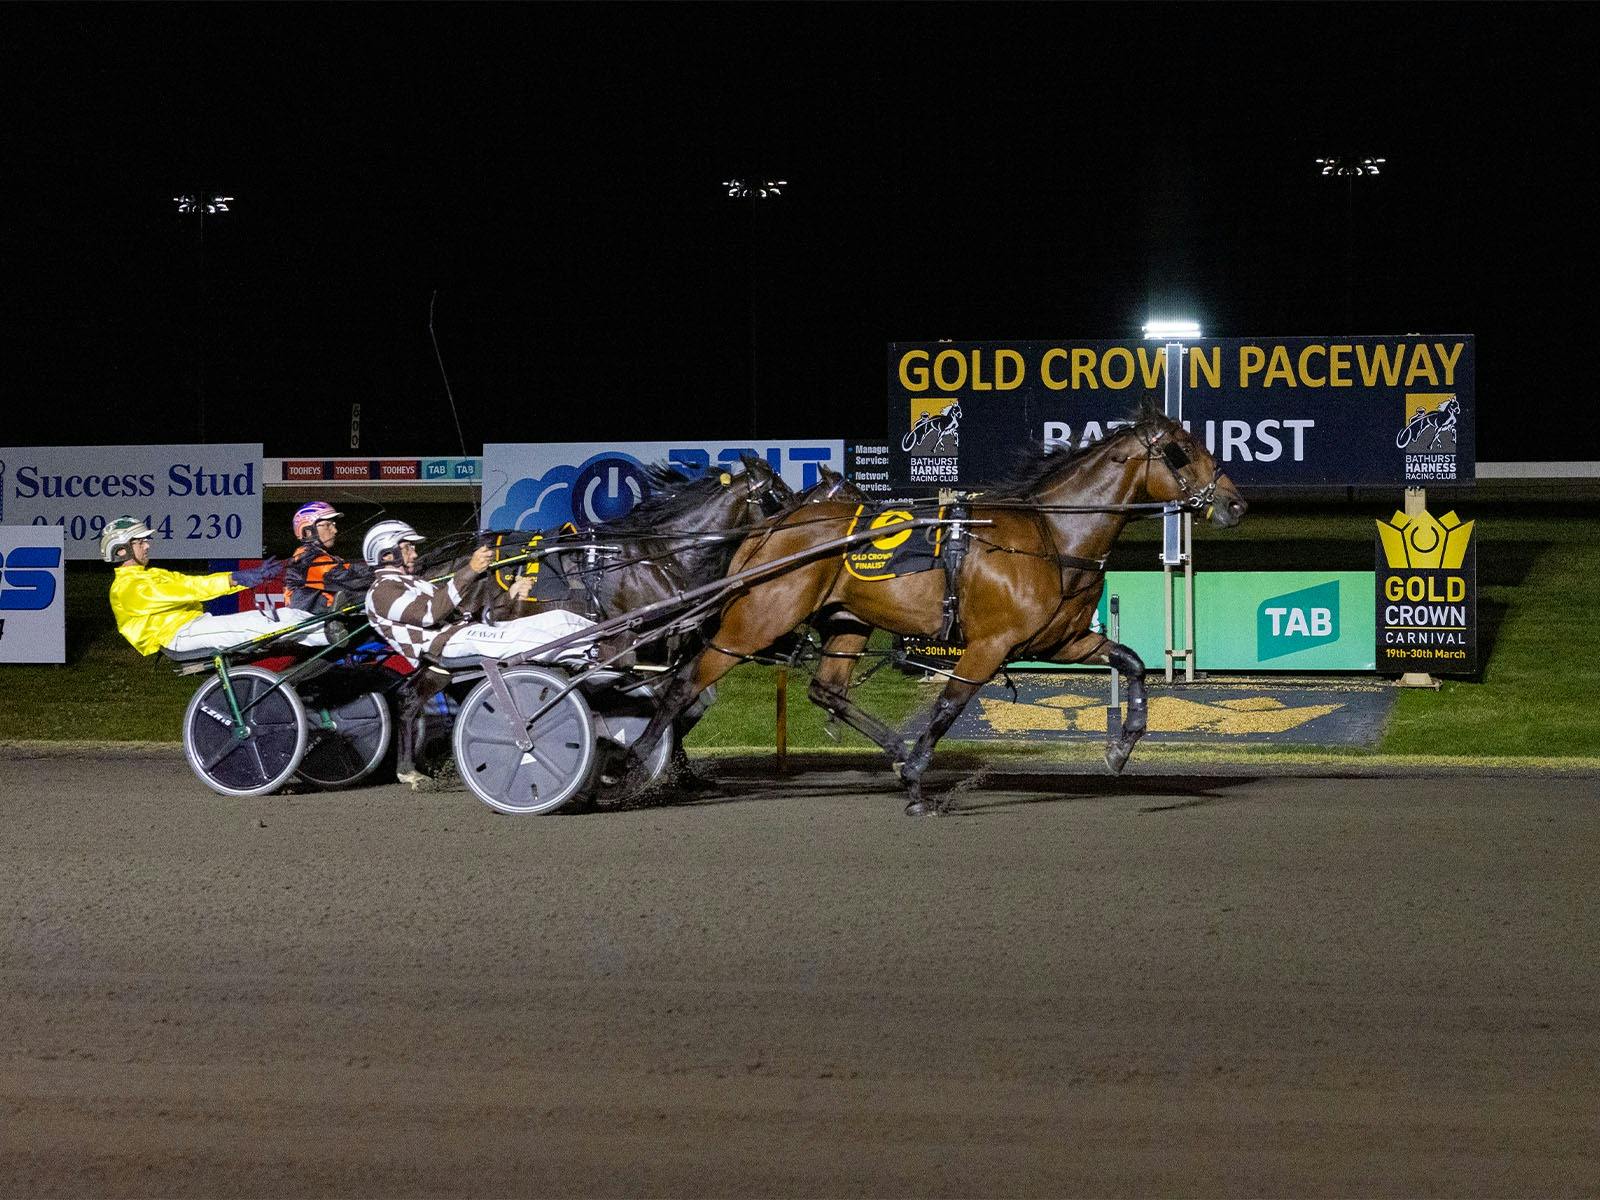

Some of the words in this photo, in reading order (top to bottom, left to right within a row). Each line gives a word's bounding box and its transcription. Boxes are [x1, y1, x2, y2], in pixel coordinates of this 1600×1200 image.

[899, 348, 1025, 391] GOLD
[1040, 347, 1221, 390] CROWN
[1240, 343, 1465, 389] PACEWAY
[1044, 419, 1315, 462] BAURST
[911, 457, 959, 466] BATHURST
[1405, 454, 1457, 463] BATHURST
[289, 466, 321, 475] TOOHEYS
[335, 466, 368, 475] TOOHEYS
[381, 465, 415, 475] TOOHEYS
[428, 465, 446, 474] TAB
[456, 465, 474, 474] TAB
[911, 466, 959, 475] HARNESS
[1405, 463, 1457, 473] HARNESS
[16, 465, 155, 499] Success
[168, 462, 256, 497] Stud
[32, 514, 107, 541] 09
[186, 513, 242, 540] 230
[1385, 576, 1466, 602] GOLD
[1385, 605, 1466, 626] CROWN
[1264, 607, 1333, 636] TAB
[1385, 632, 1466, 644] CARNIVAL
[906, 646, 946, 655] -30th
[948, 646, 967, 656] Mar
[1385, 648, 1432, 658] 19th-30th
[1434, 649, 1466, 659] March
